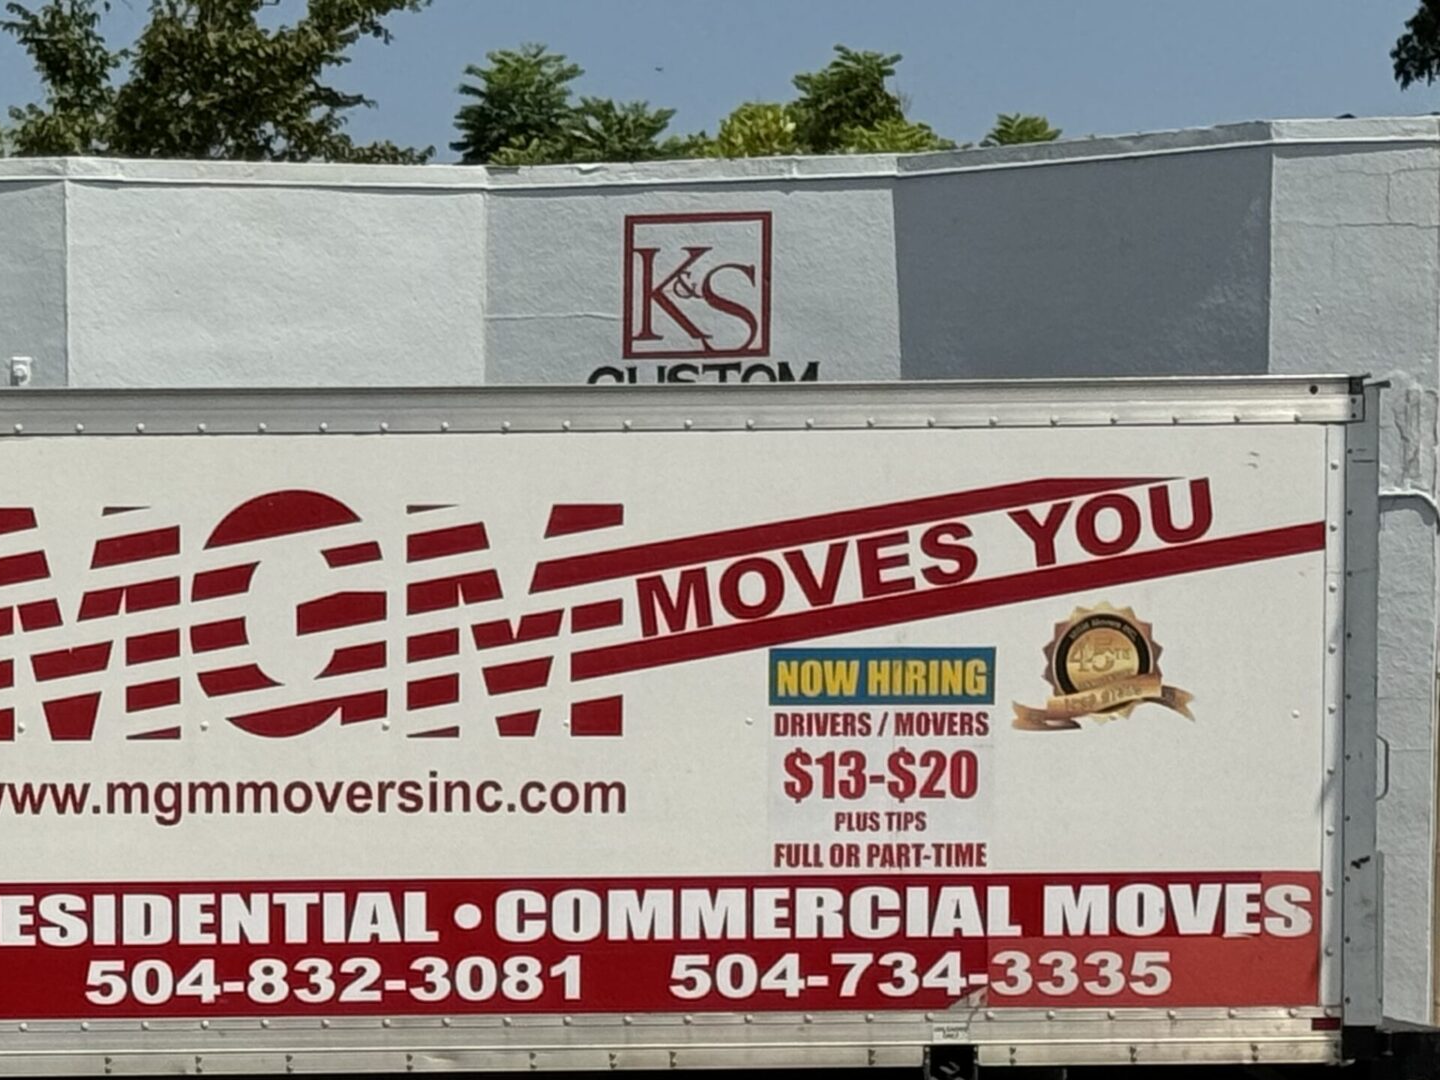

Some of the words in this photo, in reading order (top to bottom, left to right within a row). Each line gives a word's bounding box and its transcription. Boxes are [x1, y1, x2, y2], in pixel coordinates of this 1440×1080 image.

[635, 522, 979, 638] MOVES
[1007, 476, 1214, 568] YOU
[777, 660, 859, 697] NOW
[867, 659, 988, 697] HIRING
[773, 712, 872, 737] DRIVERS
[894, 711, 990, 737] MOVERS
[783, 747, 979, 803] $13-$20
[834, 811, 881, 832] PLUS
[884, 811, 928, 832] TIPS
[773, 843, 824, 868] FULL
[829, 843, 861, 868] OR
[867, 842, 988, 869] PART-TIME
[495, 885, 1023, 942] COMMERCIAL
[1043, 883, 1314, 938] MOVES
[84, 955, 581, 1005] 504-832-3081
[669, 950, 1173, 999] 504-734-3335
